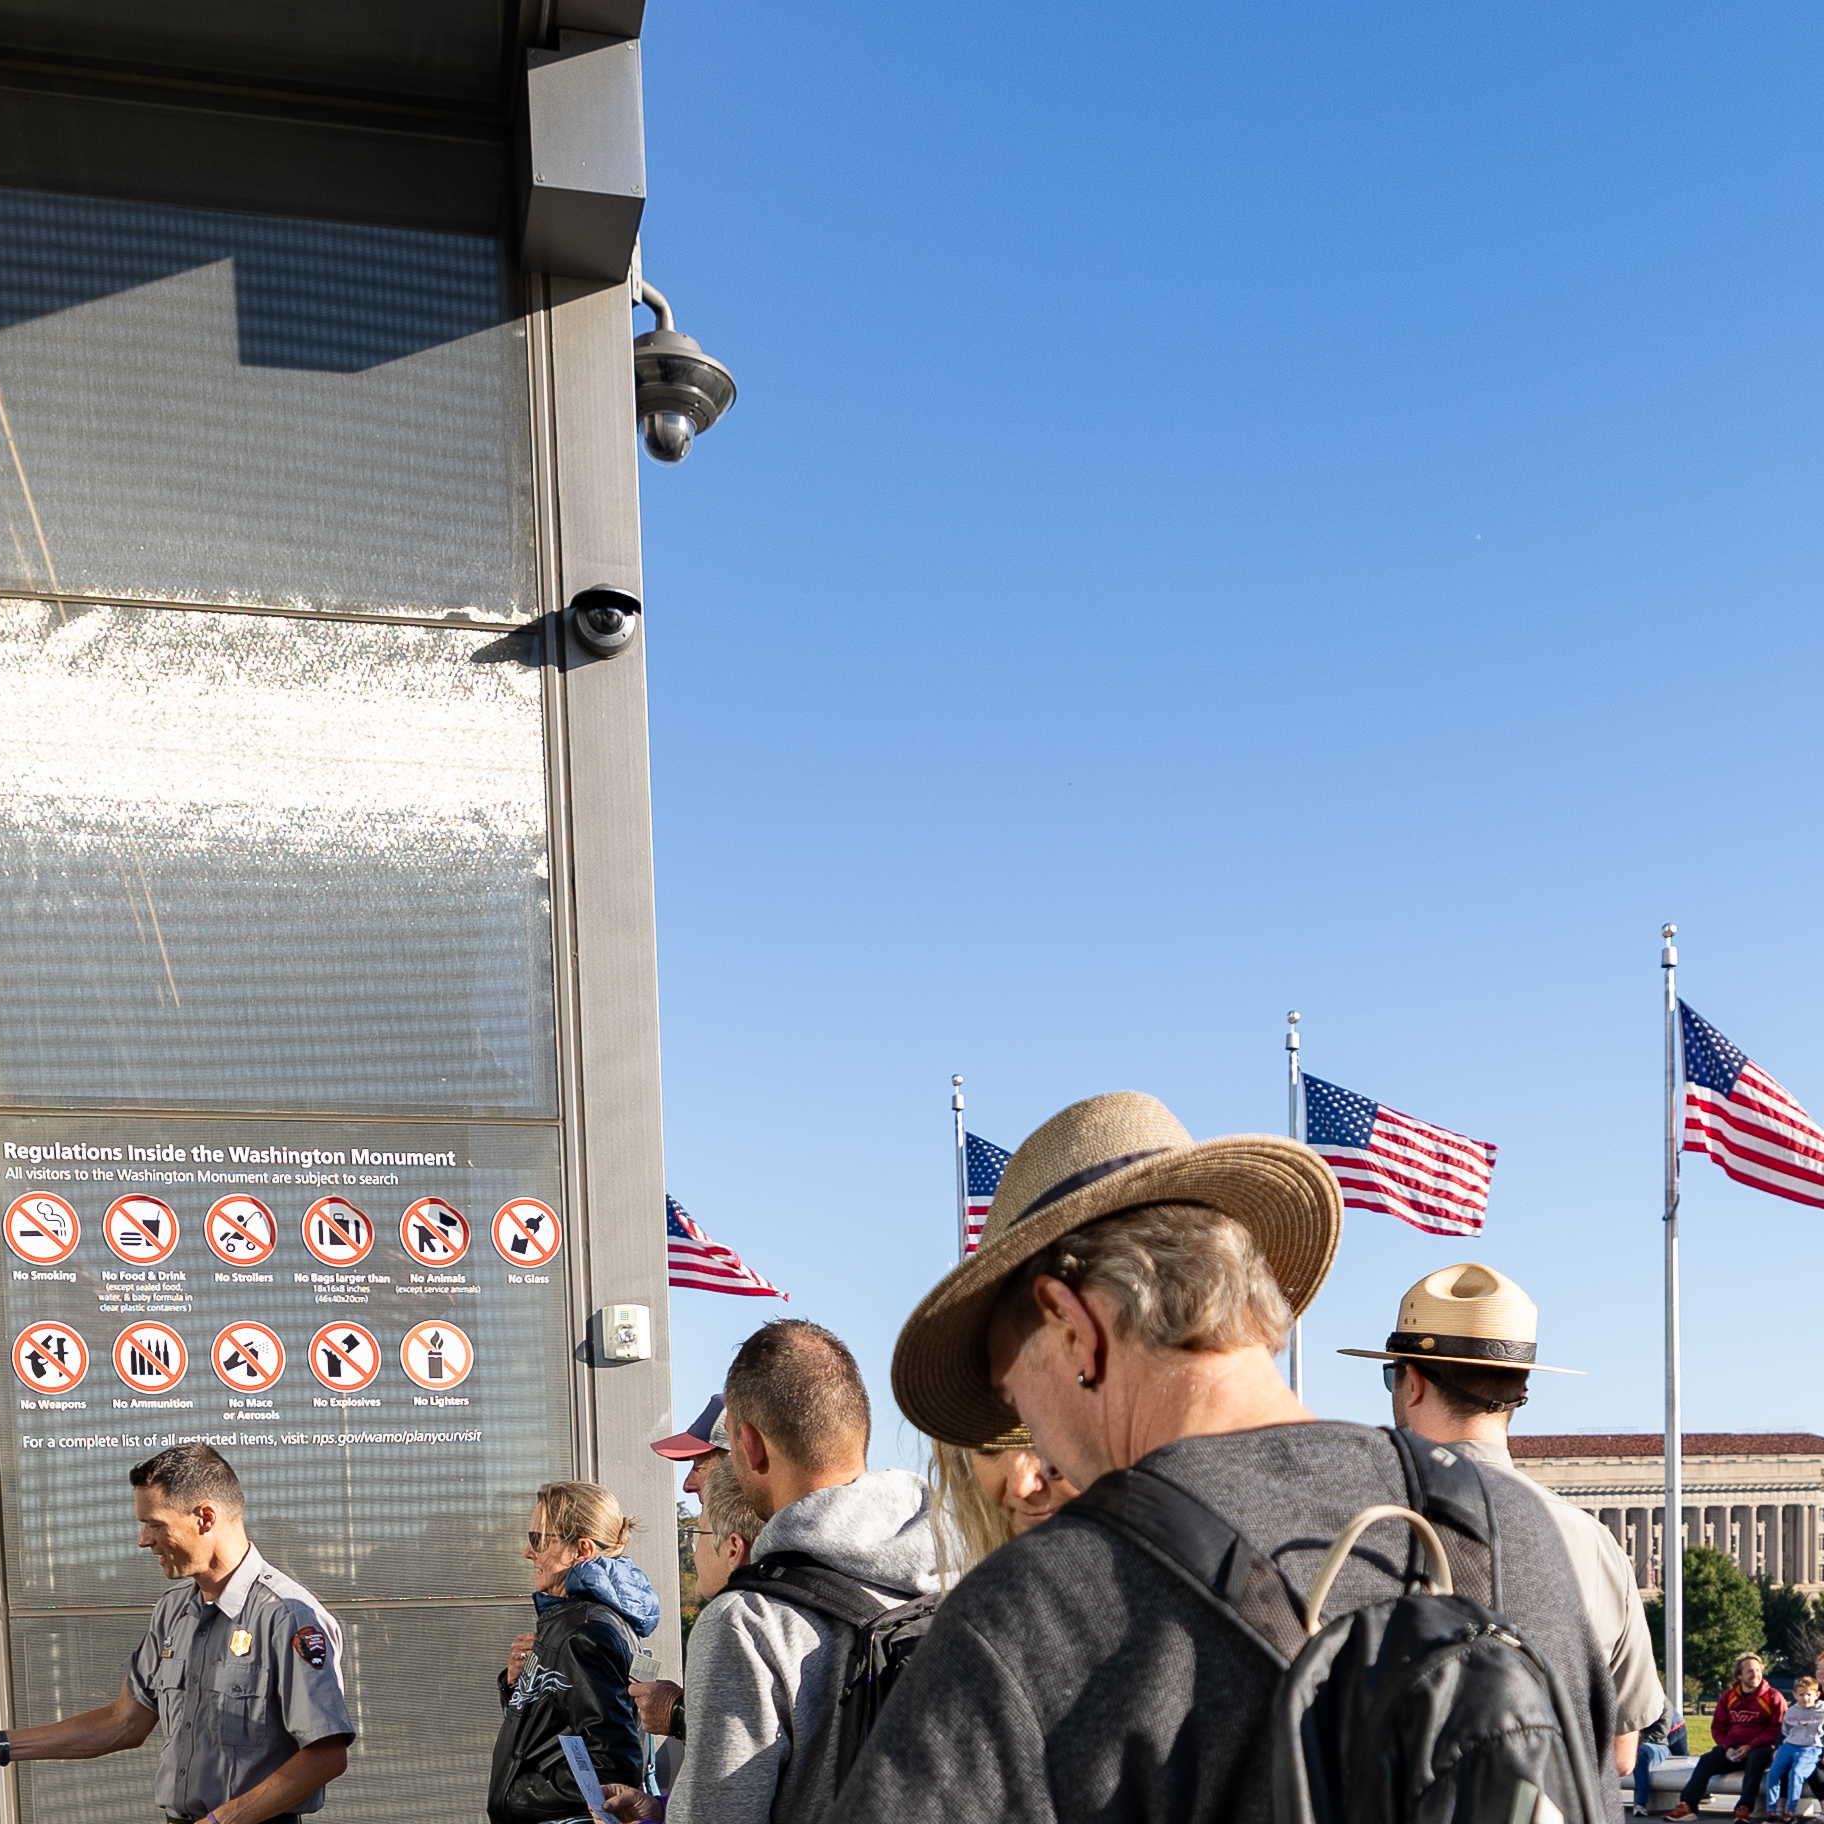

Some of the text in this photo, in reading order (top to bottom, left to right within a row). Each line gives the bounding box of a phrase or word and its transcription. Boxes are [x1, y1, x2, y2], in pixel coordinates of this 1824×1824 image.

[3, 1141, 456, 1168] Regulations Inside the Washington Monument
[4, 1166, 398, 1188] All visitors to the Washington Monument are subject to search
[13, 1270, 76, 1282] No Smoking
[102, 1271, 186, 1281] No Food & Drink
[215, 1273, 273, 1282] No Strollers
[294, 1273, 391, 1284] No Bags larger than
[410, 1274, 466, 1283] No Animals
[508, 1274, 550, 1283] No Glass
[346, 1285, 370, 1293] inches
[395, 1286, 423, 1294] (except
[132, 1293, 151, 1303] baby
[185, 1293, 193, 1301] in
[99, 1304, 118, 1312] clear
[120, 1304, 145, 1313] plastic
[20, 1400, 86, 1411] No Weapons
[112, 1399, 193, 1409] No Ammunition
[229, 1398, 273, 1408] No Mace
[313, 1397, 381, 1409] No Explosives
[413, 1396, 469, 1407] No Lighters
[236, 1410, 280, 1420] Aerosols
[23, 1429, 482, 1450] For a complete list of all restricted items, visit: nps.gov/wamo/planyourvisit
